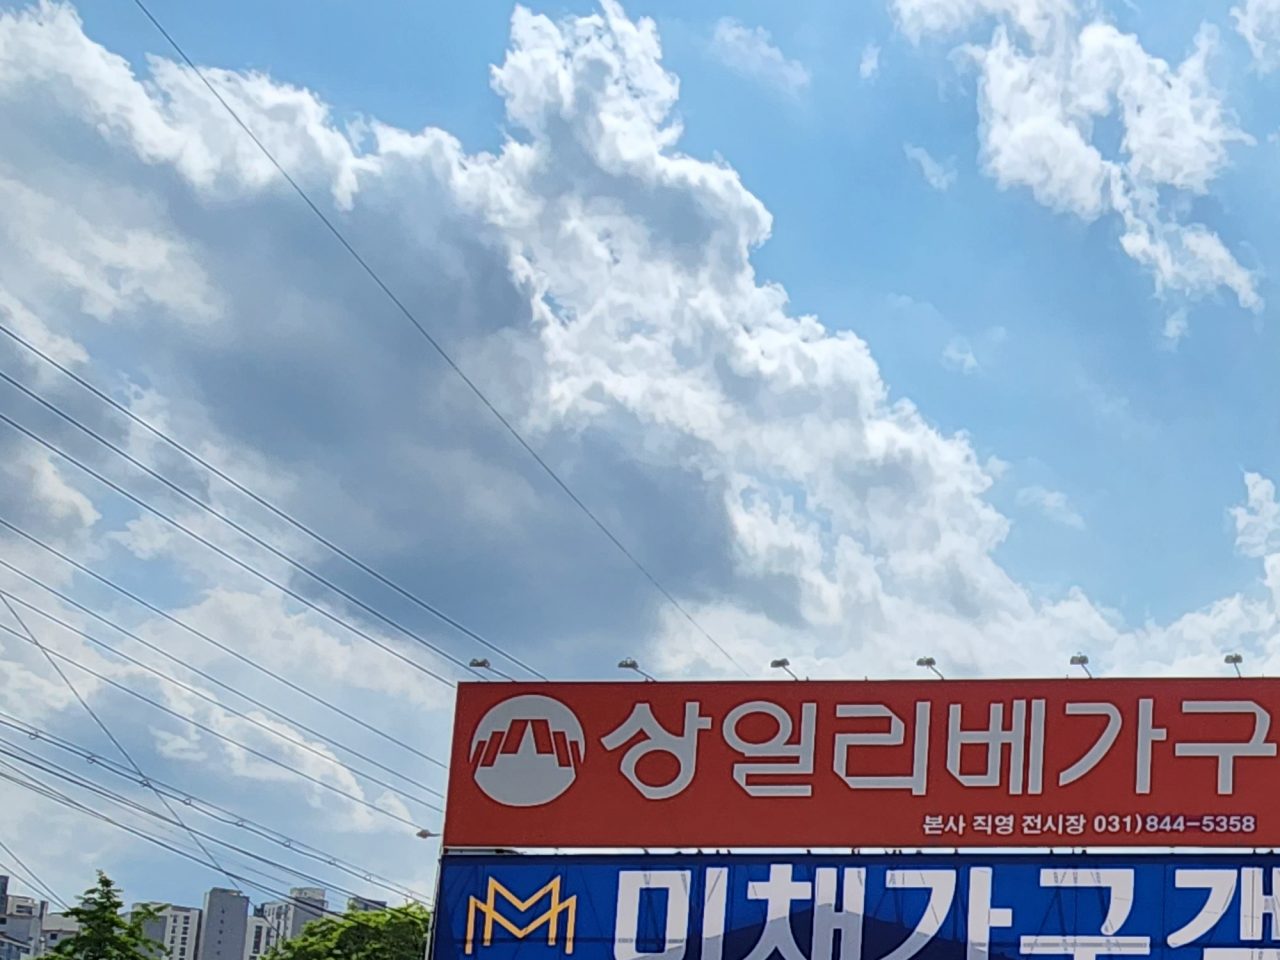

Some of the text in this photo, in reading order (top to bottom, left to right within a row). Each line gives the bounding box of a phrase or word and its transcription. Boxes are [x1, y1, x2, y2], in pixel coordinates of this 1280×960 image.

[601, 699, 1278, 800] 상일리베가구
[922, 813, 1257, 835] 본사 직영 전시장 031)844-5358
